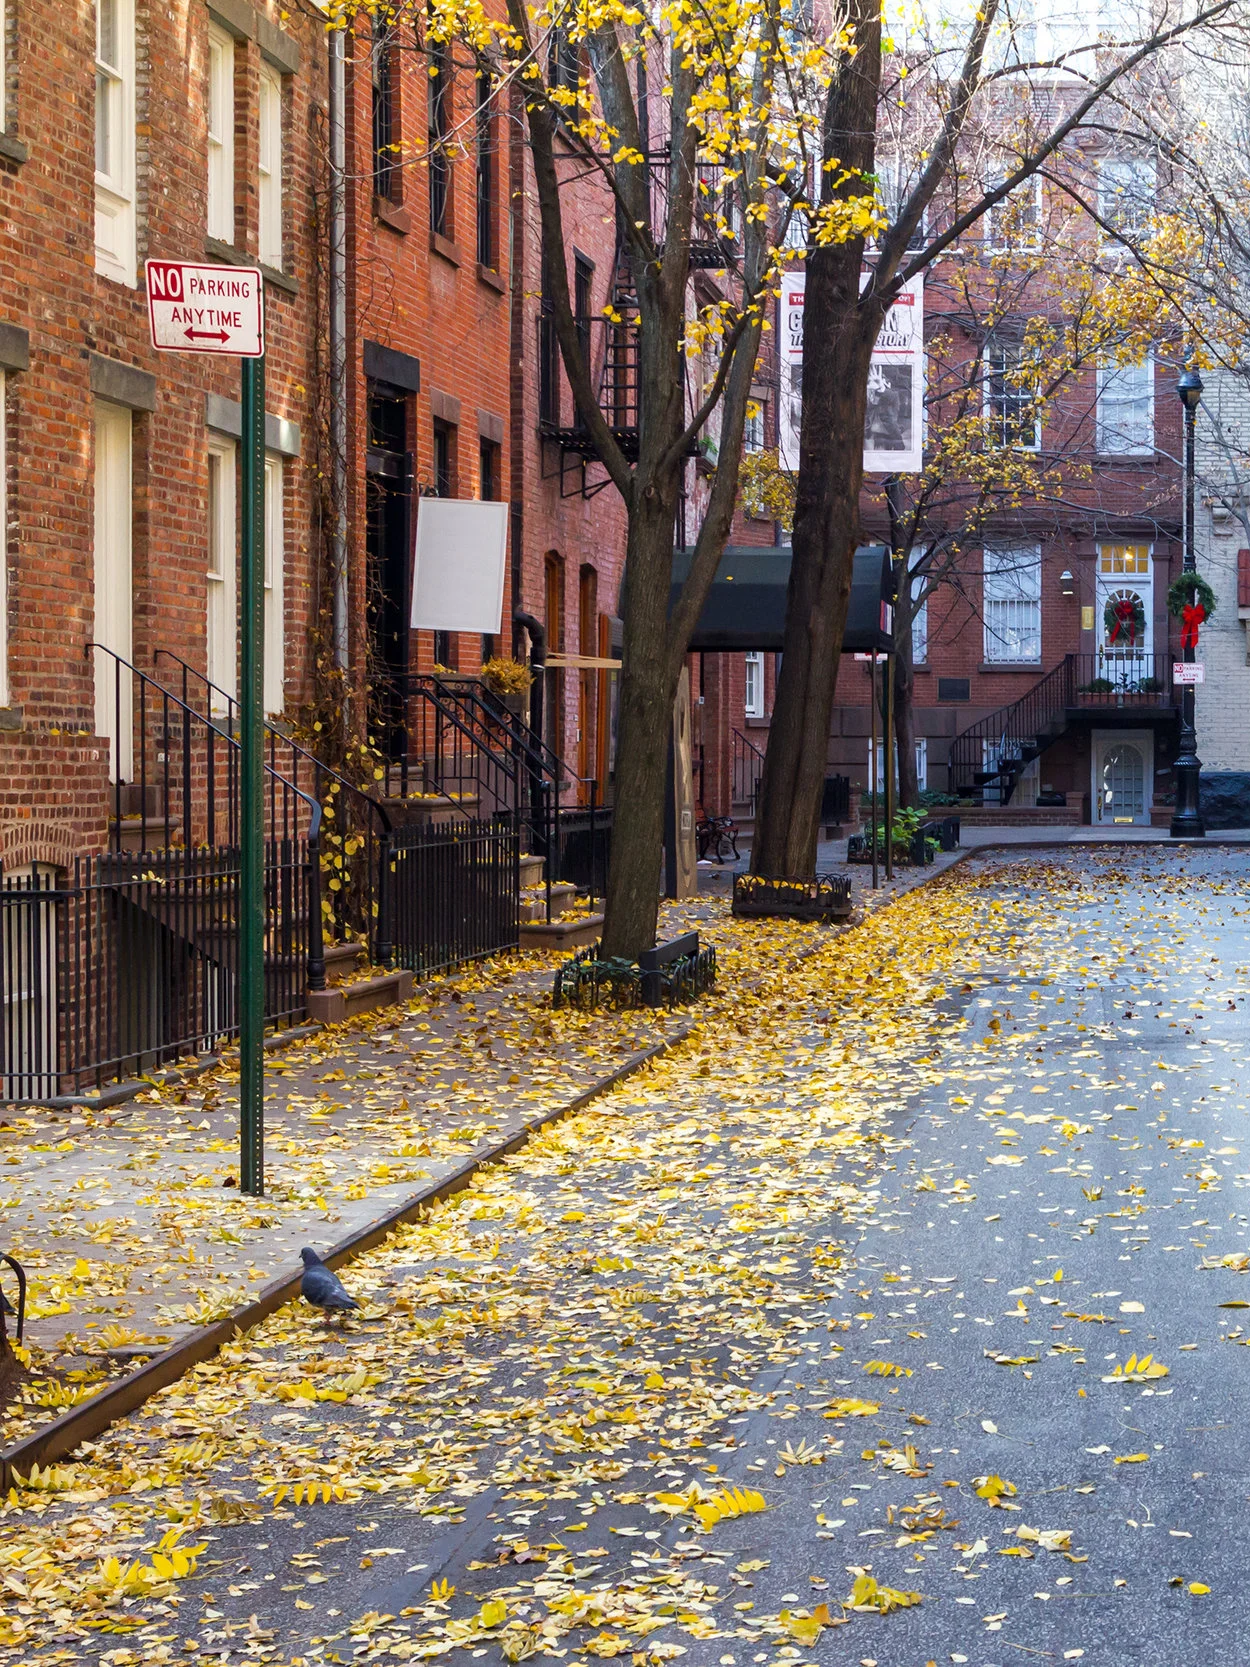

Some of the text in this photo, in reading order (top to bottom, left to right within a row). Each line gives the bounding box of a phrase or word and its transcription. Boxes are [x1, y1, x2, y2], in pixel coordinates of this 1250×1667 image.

[150, 267, 250, 299] NO PARKING
[792, 295, 804, 303] TH
[171, 306, 242, 328] ANYTIME
